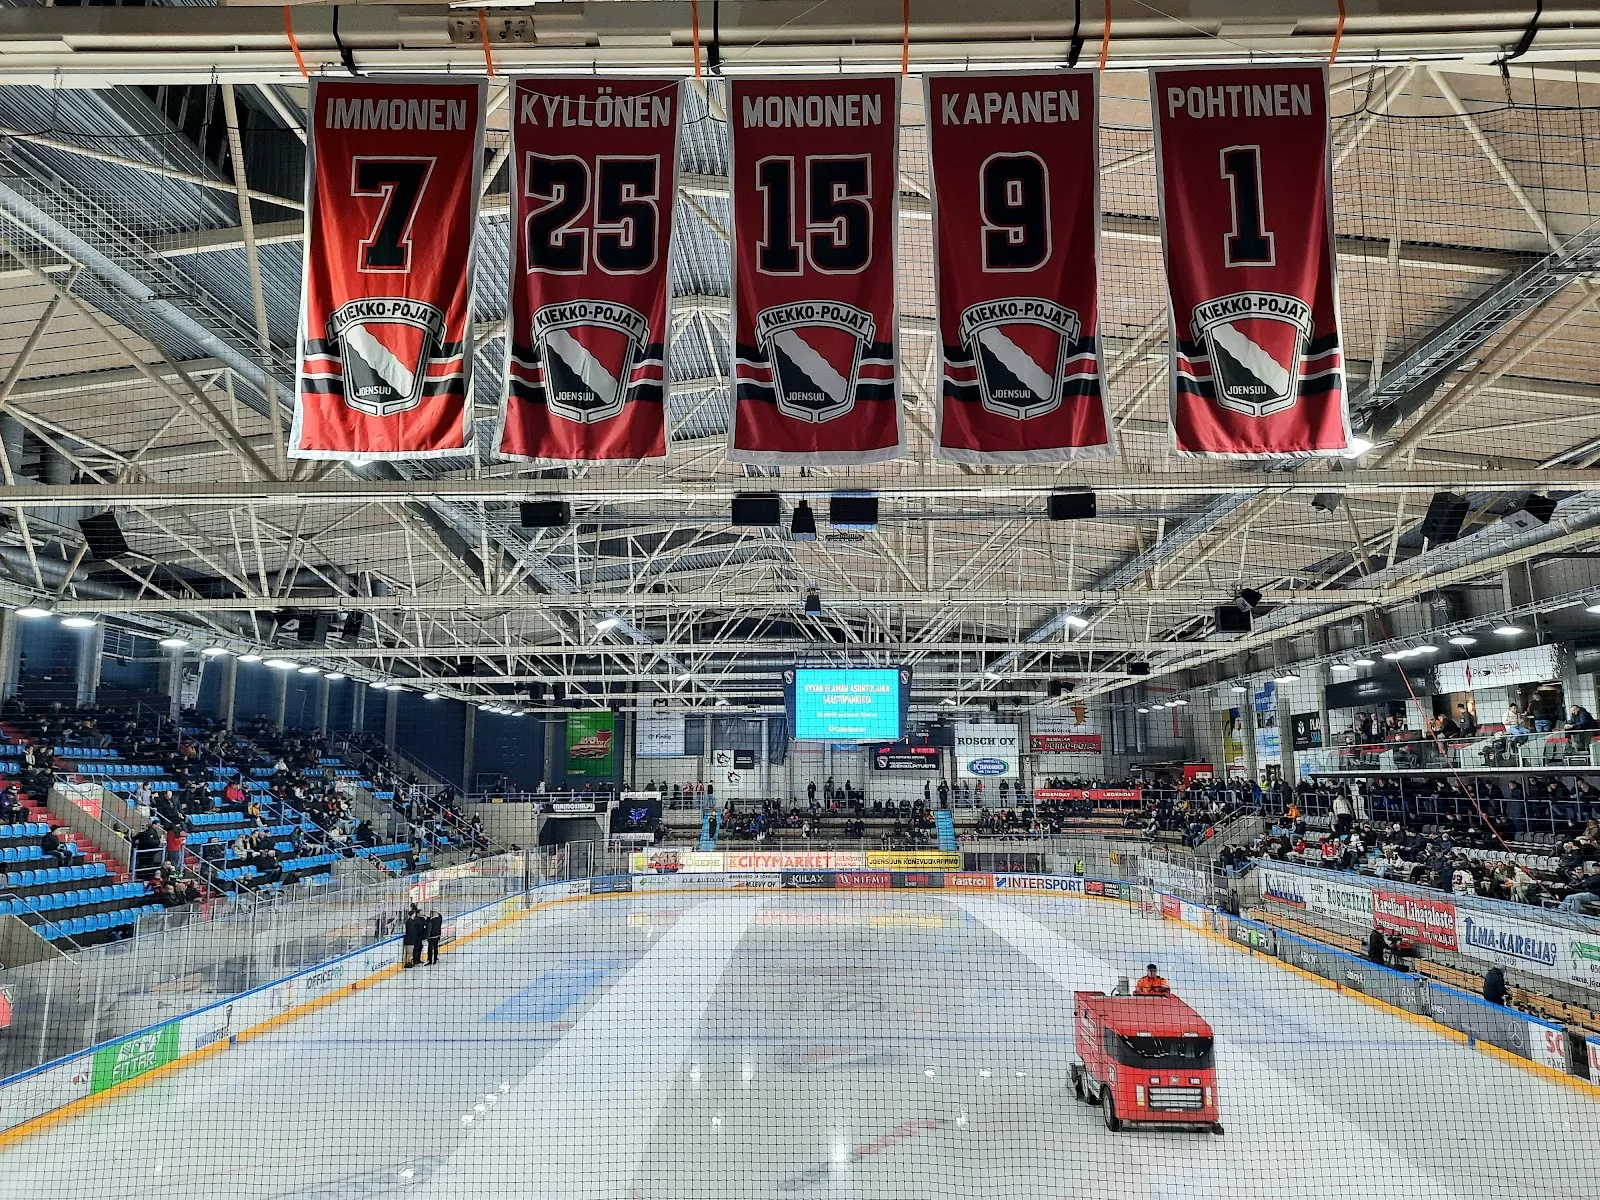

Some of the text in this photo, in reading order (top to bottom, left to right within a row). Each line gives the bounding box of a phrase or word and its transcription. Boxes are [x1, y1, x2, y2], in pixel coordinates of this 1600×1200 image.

[326, 97, 467, 131] IMMONEN
[520, 86, 671, 128] KYLLÖNEN
[742, 93, 882, 129] MONONEN
[942, 89, 1081, 126] KAPANEN
[1167, 83, 1313, 119] POHTINEN
[350, 155, 438, 274] 7
[524, 150, 661, 276] 25
[755, 152, 873, 276] 15
[978, 151, 1052, 274] 9
[1219, 144, 1276, 268] 1
[335, 301, 438, 328] KIEKKO-POJAT
[535, 303, 642, 331] KIEKKO-POJAT
[761, 303, 869, 332] KIEKKO-POJAT
[965, 300, 1077, 330] KIEKKO-POJAT
[1199, 294, 1309, 322] KIEKKO-POJAT
[356, 384, 393, 398] JOENSUU
[555, 390, 596, 403] JOENSUU
[786, 390, 826, 403] JOENSUU
[991, 388, 1031, 400] JOENSUU
[1226, 384, 1267, 397] JOENSUU
[999, 737, 1016, 746] OY
[738, 855, 832, 868] CITYMARKET
[1008, 876, 1083, 893] INTERSPORT
[1373, 893, 1406, 919] Karelian
[1405, 900, 1454, 930] Lihajaloste
